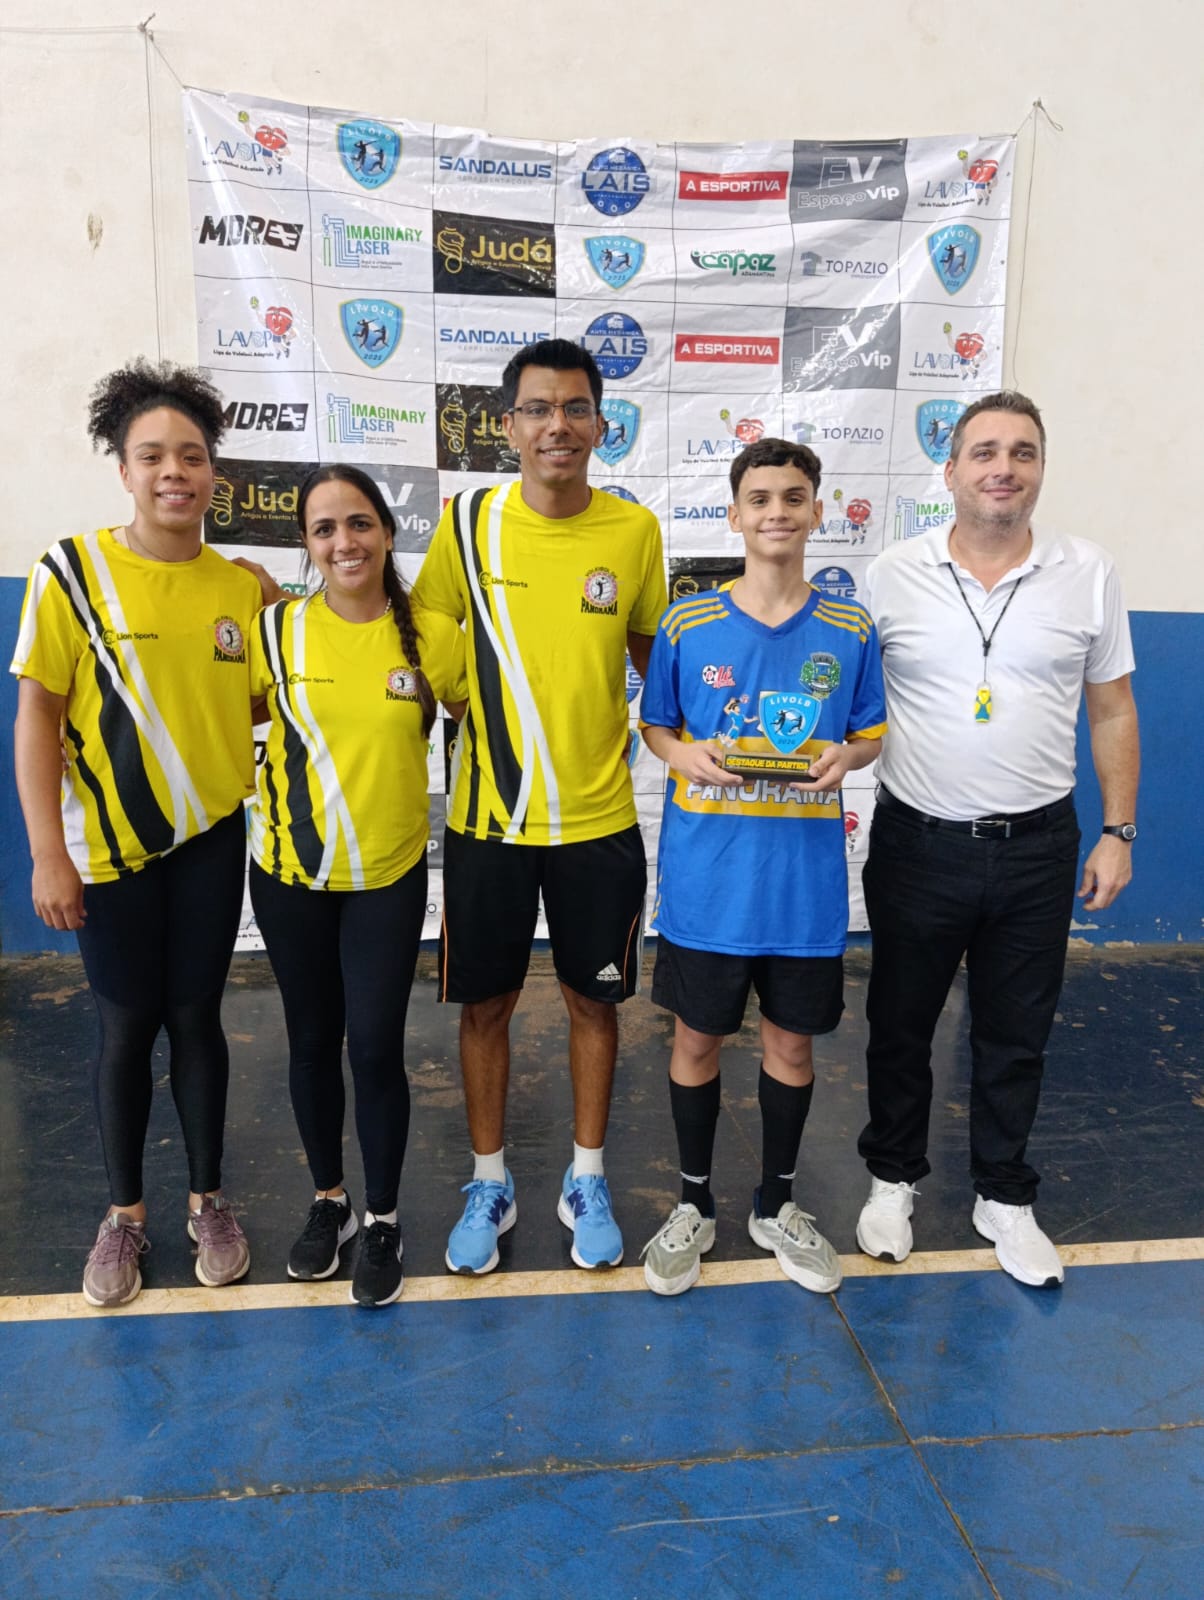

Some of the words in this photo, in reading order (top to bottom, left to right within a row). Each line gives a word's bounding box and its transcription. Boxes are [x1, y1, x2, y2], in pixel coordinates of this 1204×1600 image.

[439, 156, 552, 178] SANDALUS
[818, 155, 882, 189] EV
[581, 171, 650, 192] LAIS
[686, 179, 697, 192] A
[700, 179, 781, 193] ESPORTIVA
[346, 225, 423, 242] IMAGINARY
[347, 239, 390, 255] LASER
[471, 235, 552, 263] Judá
[826, 260, 889, 275] TOPAZIO
[681, 343, 692, 354] A
[695, 343, 774, 357] ESPORTIVA
[351, 403, 426, 424] IMAGINARY
[352, 417, 395, 432] LASER
[472, 410, 507, 437] Ju
[821, 427, 884, 440] TOPAZIO
[240, 484, 299, 513] Jud
[674, 506, 728, 519] SAND
[134, 632, 158, 640] Sports
[386, 689, 418, 703] PANORAM
[769, 695, 812, 708] LIVOLB
[726, 757, 765, 768] DESTAQUE
[765, 760, 776, 768] DA
[777, 761, 809, 771] PARTIDA
[686, 779, 840, 805] PANORAMA
